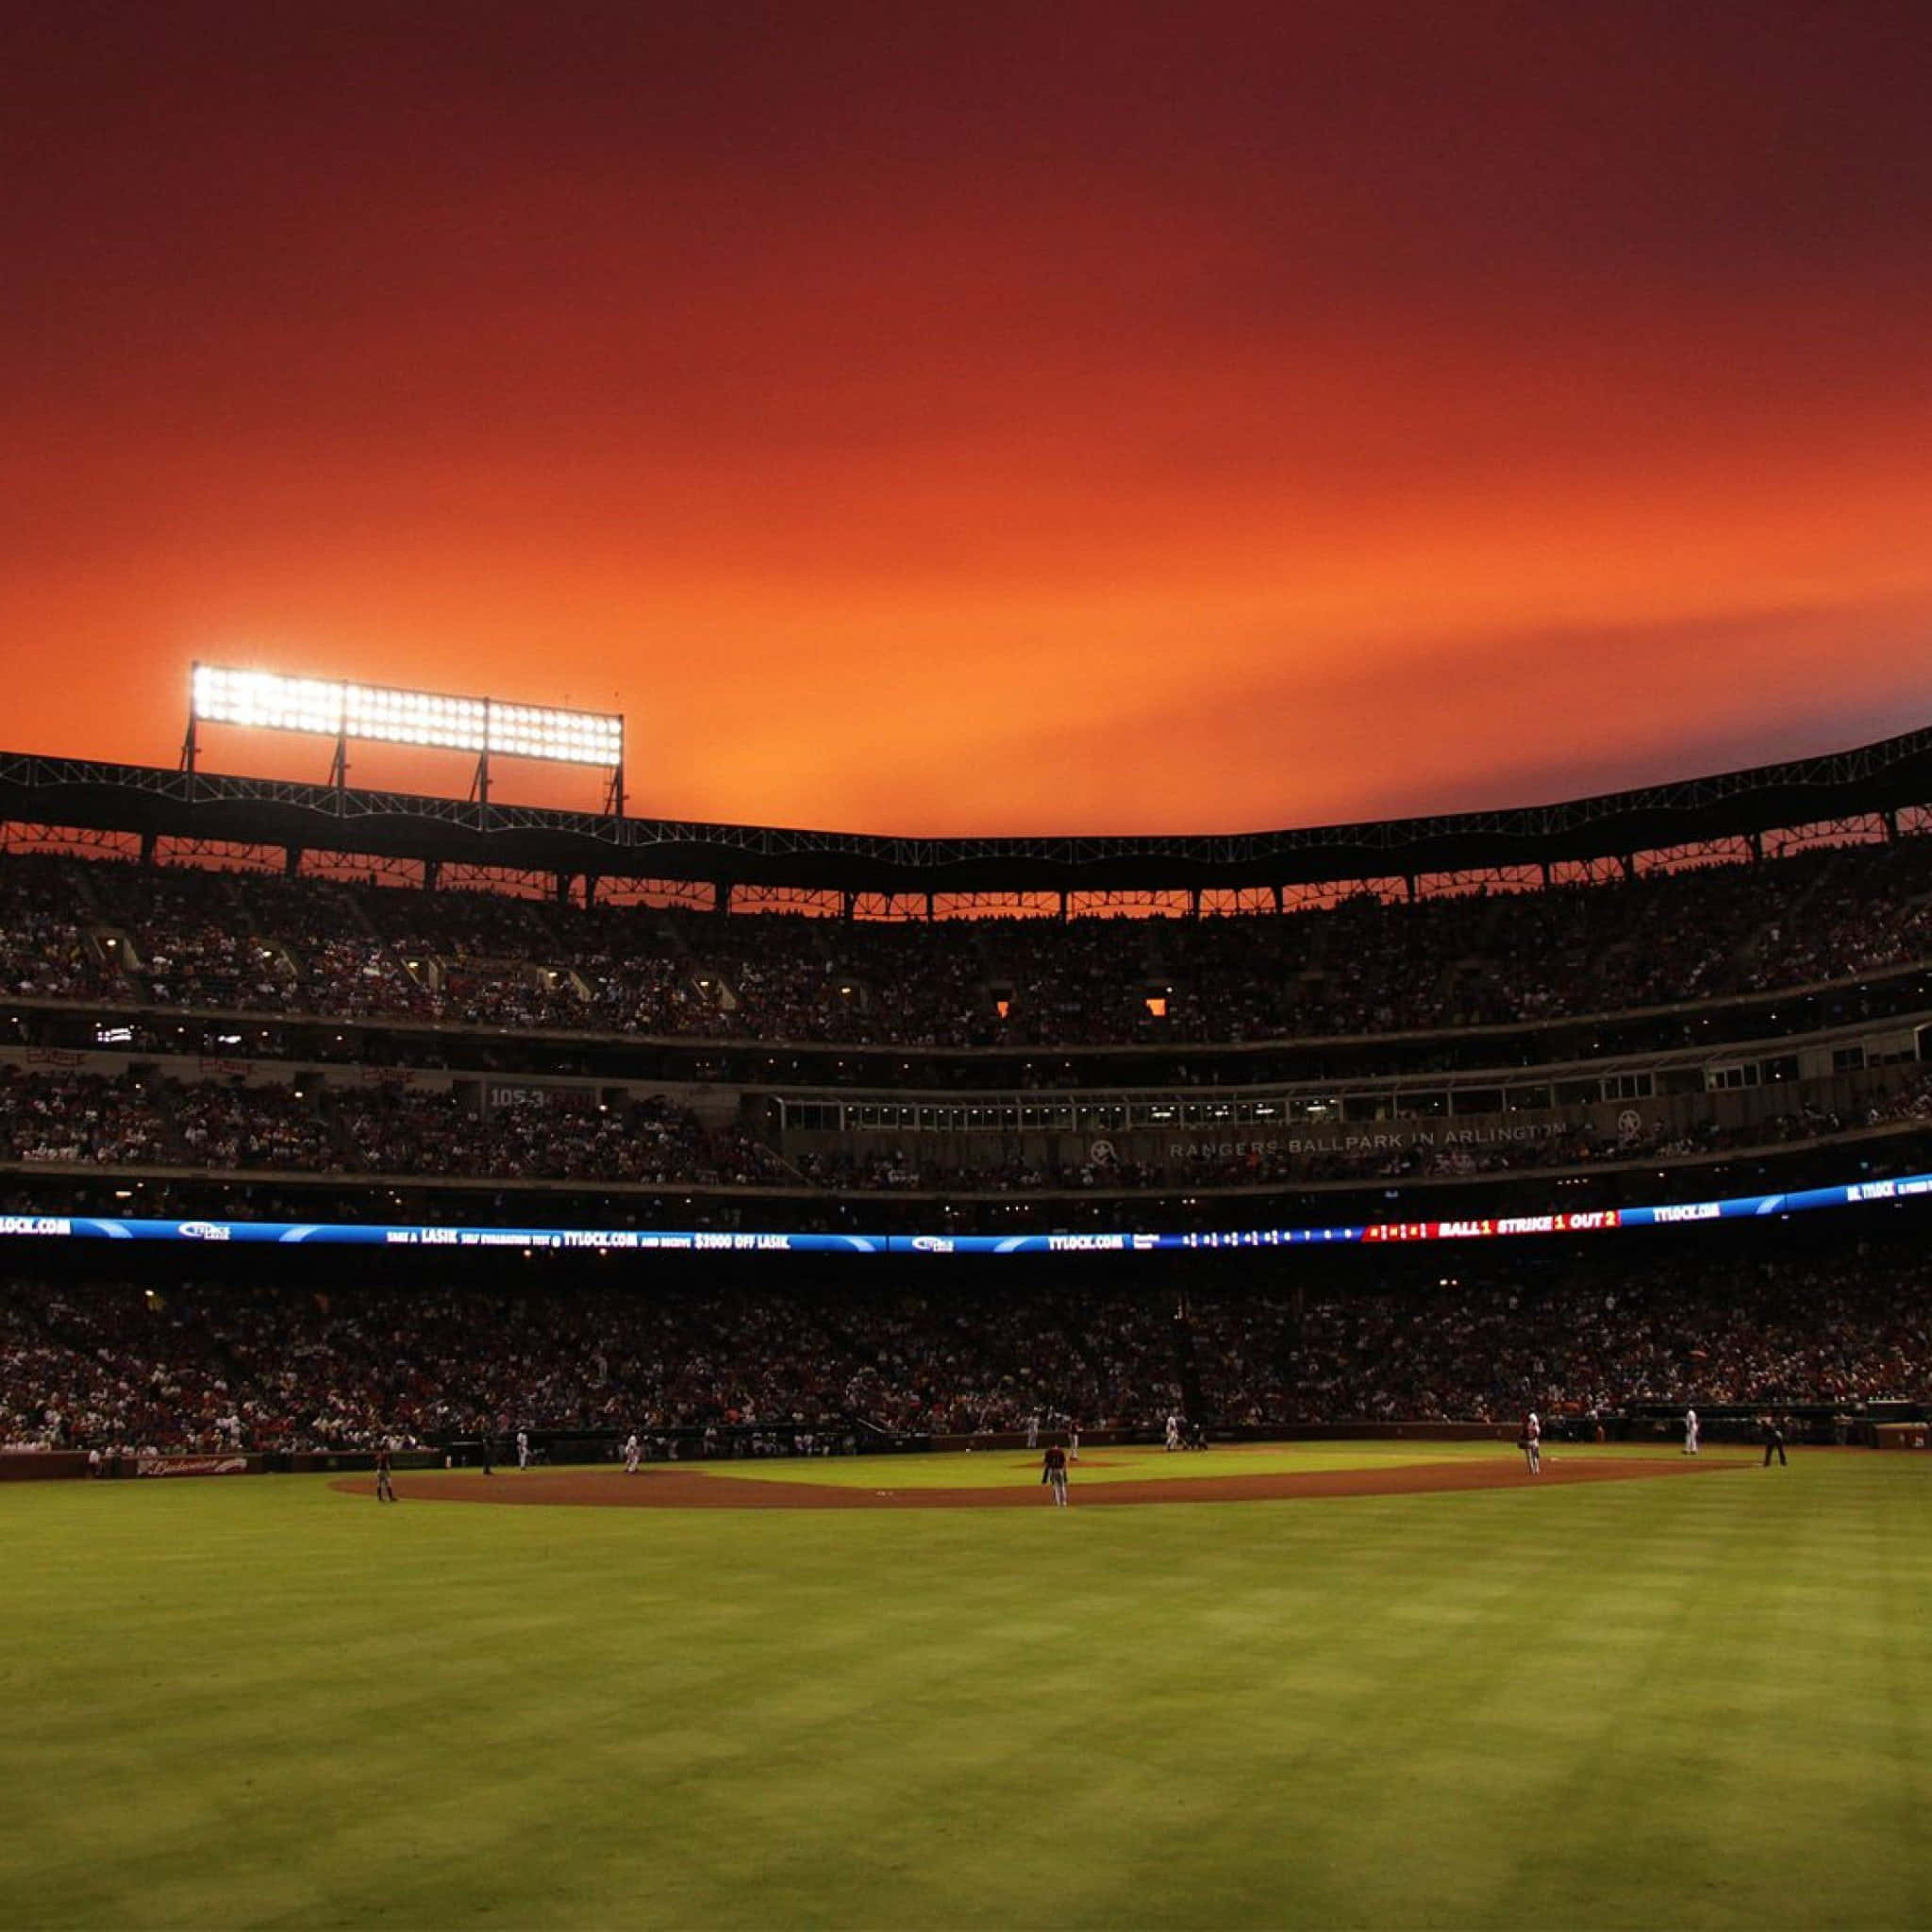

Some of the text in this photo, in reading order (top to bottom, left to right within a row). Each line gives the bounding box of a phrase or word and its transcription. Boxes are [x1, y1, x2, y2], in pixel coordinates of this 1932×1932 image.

[1170, 1140, 1277, 1158] RANGERS
[1289, 1134, 1404, 1155] BALLPARK
[1411, 1131, 1434, 1146] IN
[1439, 1222, 1480, 1237] BALL
[1480, 1220, 1491, 1234] 1
[1497, 1216, 1553, 1234] STRIKE
[1554, 1215, 1566, 1230] 1
[1570, 1212, 1604, 1229] OUT
[1606, 1210, 1617, 1226] 2
[422, 1228, 458, 1243] LASIK
[564, 1231, 638, 1246] TYLOCK.COM
[735, 1234, 756, 1248] OFF
[1048, 1236, 1124, 1250] TYLOCK.COM
